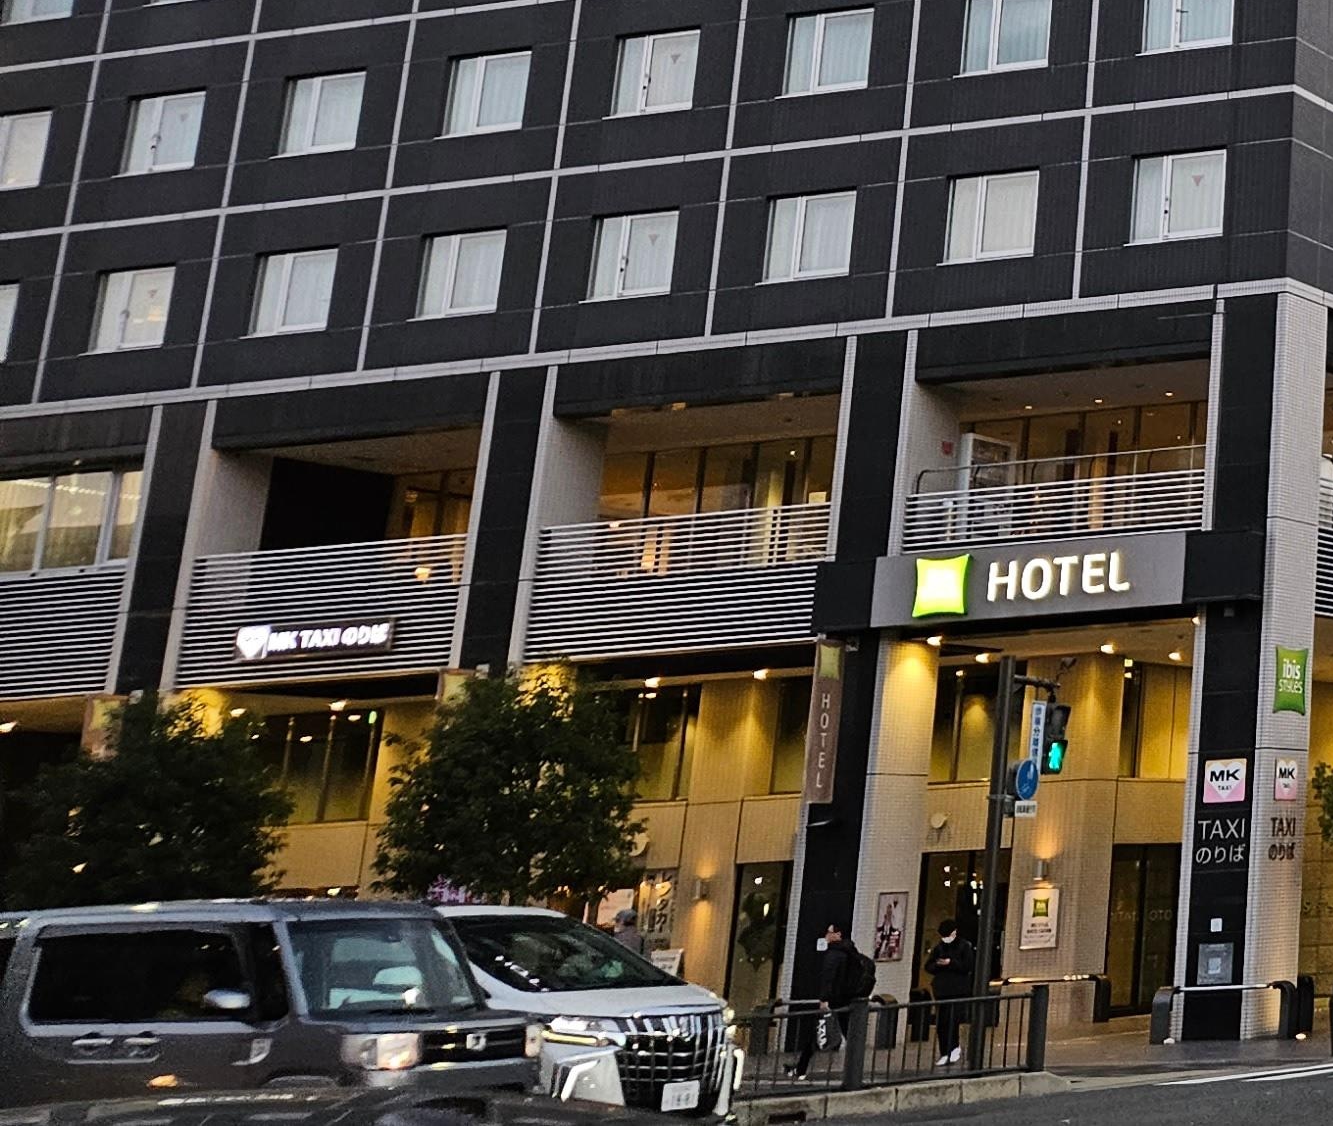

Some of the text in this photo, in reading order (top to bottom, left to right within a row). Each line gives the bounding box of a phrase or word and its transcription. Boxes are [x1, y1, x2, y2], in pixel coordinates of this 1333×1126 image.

[986, 549, 1131, 602] HOTEL
[267, 630, 299, 652] MK
[299, 627, 342, 649] TAXI
[1282, 658, 1301, 680] ibis
[815, 693, 831, 790] HOTEL
[1209, 767, 1241, 783] MK
[1278, 766, 1296, 780] MK
[1198, 817, 1246, 840] TAXI
[1270, 816, 1296, 838] TAXI
[1195, 842, 1246, 865] のりば
[1268, 841, 1296, 862] のりば
